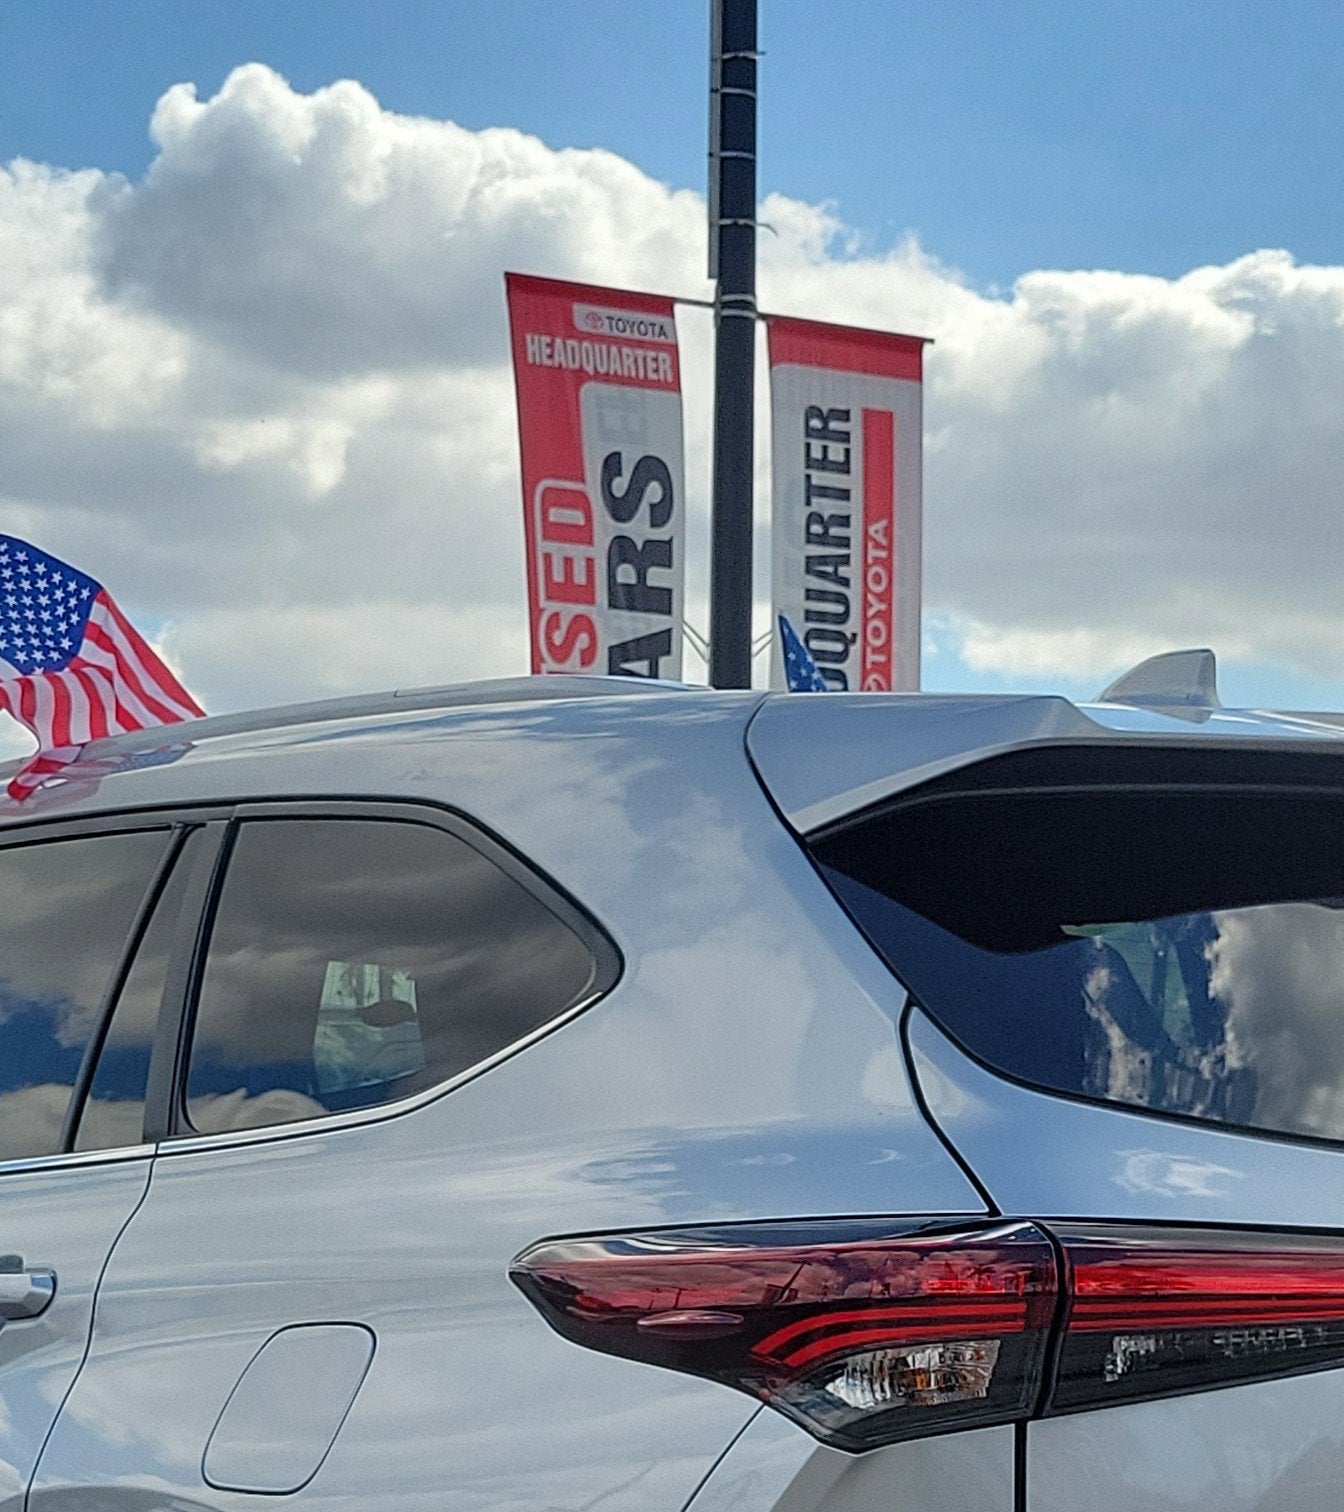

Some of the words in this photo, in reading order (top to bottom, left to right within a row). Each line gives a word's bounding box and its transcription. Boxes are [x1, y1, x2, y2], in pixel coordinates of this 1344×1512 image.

[524, 332, 674, 383] HEADQUARTER
[605, 315, 669, 340] TOYOTA
[539, 483, 598, 676] SED
[601, 450, 674, 679] ARS
[866, 517, 889, 670] TOYOTA
